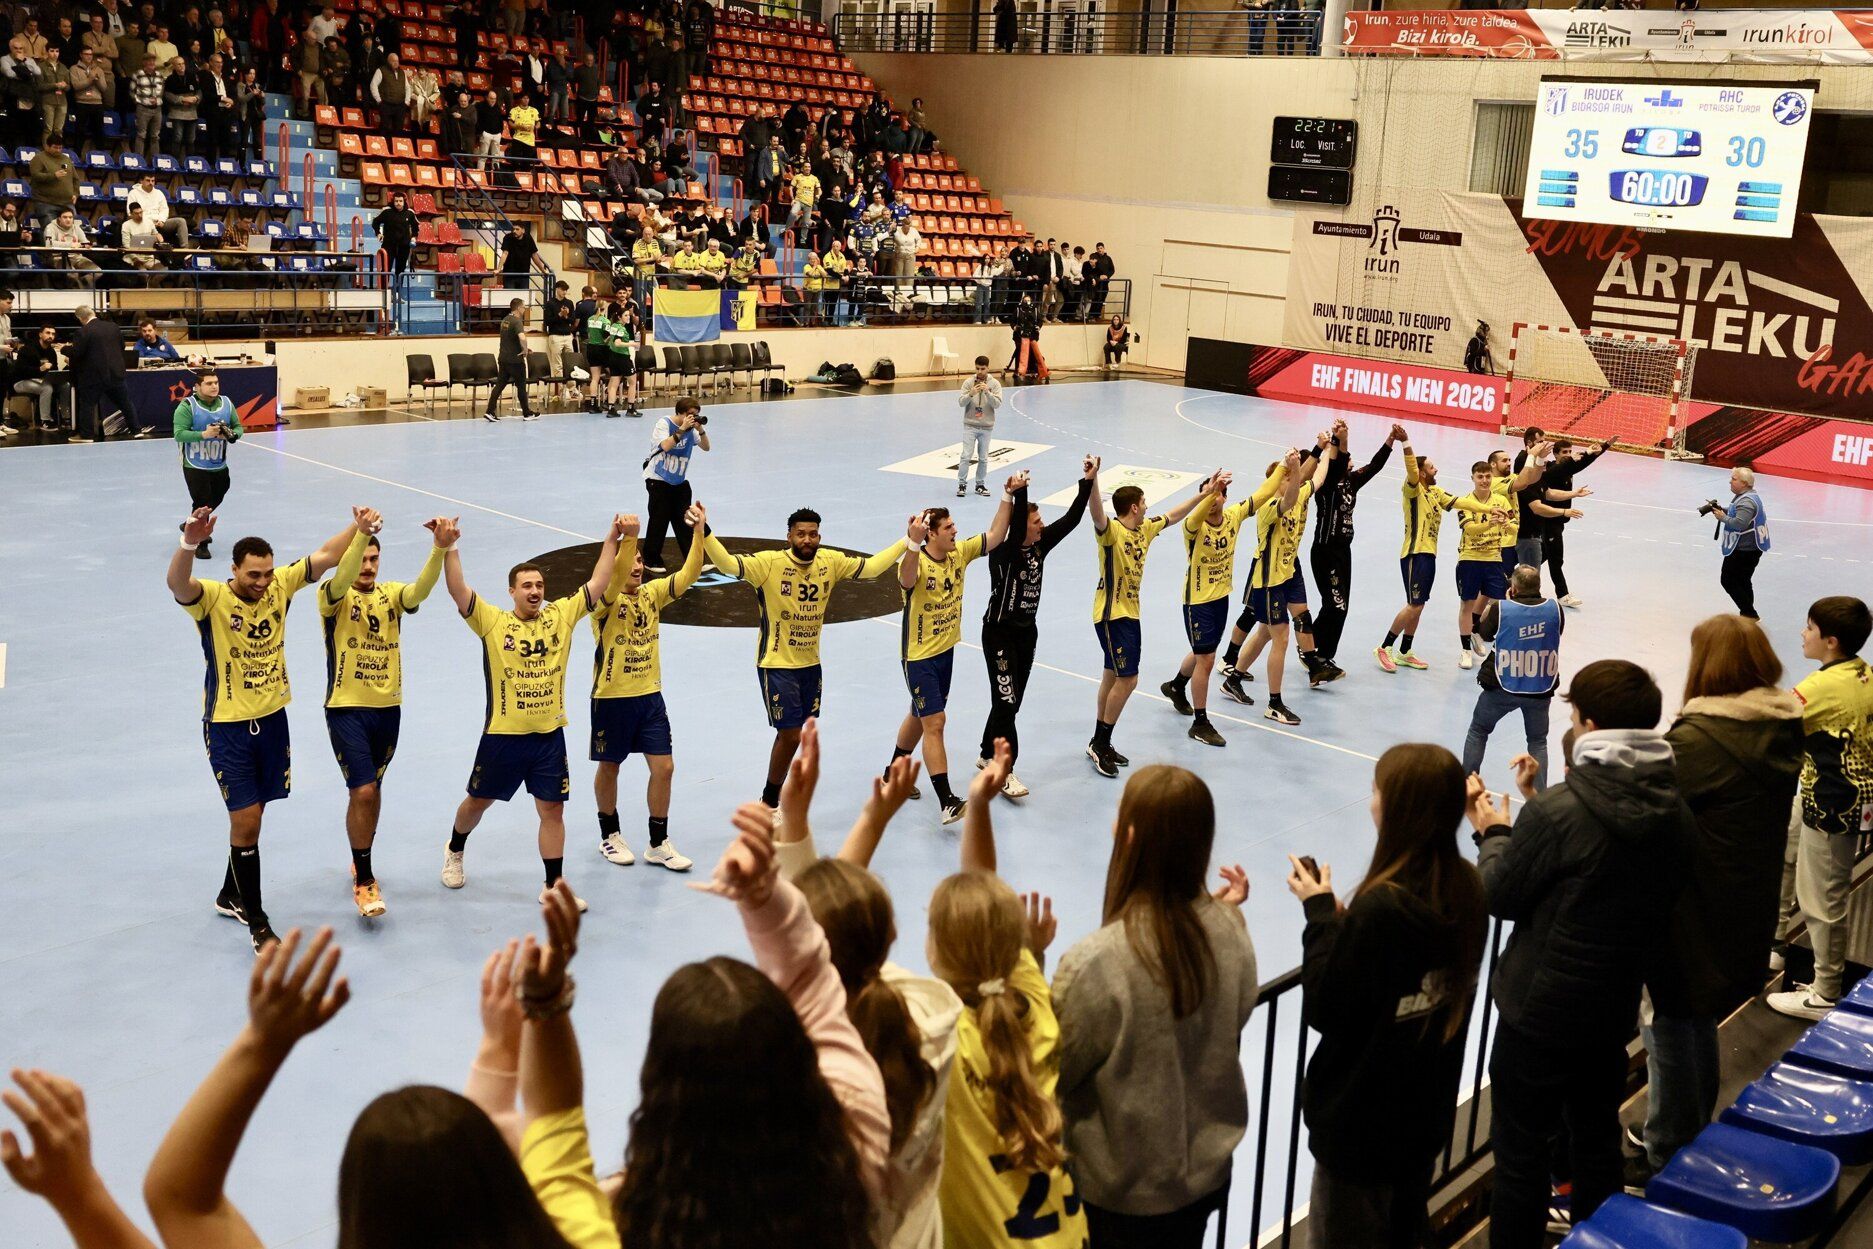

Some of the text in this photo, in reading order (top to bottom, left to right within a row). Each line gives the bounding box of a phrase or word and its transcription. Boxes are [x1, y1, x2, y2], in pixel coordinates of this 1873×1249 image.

[1364, 12, 1392, 28] Irun,
[1395, 15, 1419, 26] zure
[1422, 12, 1449, 28] hiria,
[1453, 15, 1477, 28] zure
[1566, 22, 1609, 35] ARTA
[1397, 29, 1480, 46] Bizi kirola.
[1589, 35, 1631, 49] LEKU
[1583, 88, 1624, 102] IRUDEK
[1719, 89, 1744, 104] AHC
[1570, 101, 1610, 113] BIDASOA
[1612, 102, 1634, 114] IRUN
[1698, 102, 1761, 113] POTAISSA TURDA
[1295, 119, 1336, 133] 22:21
[1563, 127, 1600, 159] 35
[1656, 135, 1667, 150] 2
[1725, 135, 1767, 169] 30
[1621, 170, 1693, 206] 60:00
[1317, 223, 1368, 236] Ayuntamiento
[1418, 231, 1441, 242] Udala
[1364, 257, 1400, 274] irun
[1596, 251, 1750, 306] ARTA
[1312, 302, 1451, 332] IRUN, TU CIUDAD, TU EQUIPO
[1325, 323, 1435, 354] VIVE EL DEPORTE
[1679, 304, 1837, 362] LEKU
[1311, 363, 1497, 413] EHF FINALS MEN 2026
[1831, 432, 1873, 467] EHF
[798, 583, 820, 602] 32
[799, 603, 818, 612] irun
[247, 618, 273, 640] 28
[366, 614, 380, 633] 9
[1518, 621, 1546, 638] EHF
[519, 638, 550, 658] 34
[523, 659, 547, 670] irun
[1497, 648, 1558, 678] PHOTO
[516, 687, 555, 699] KIROLAK
[525, 699, 555, 709] MOYUA
